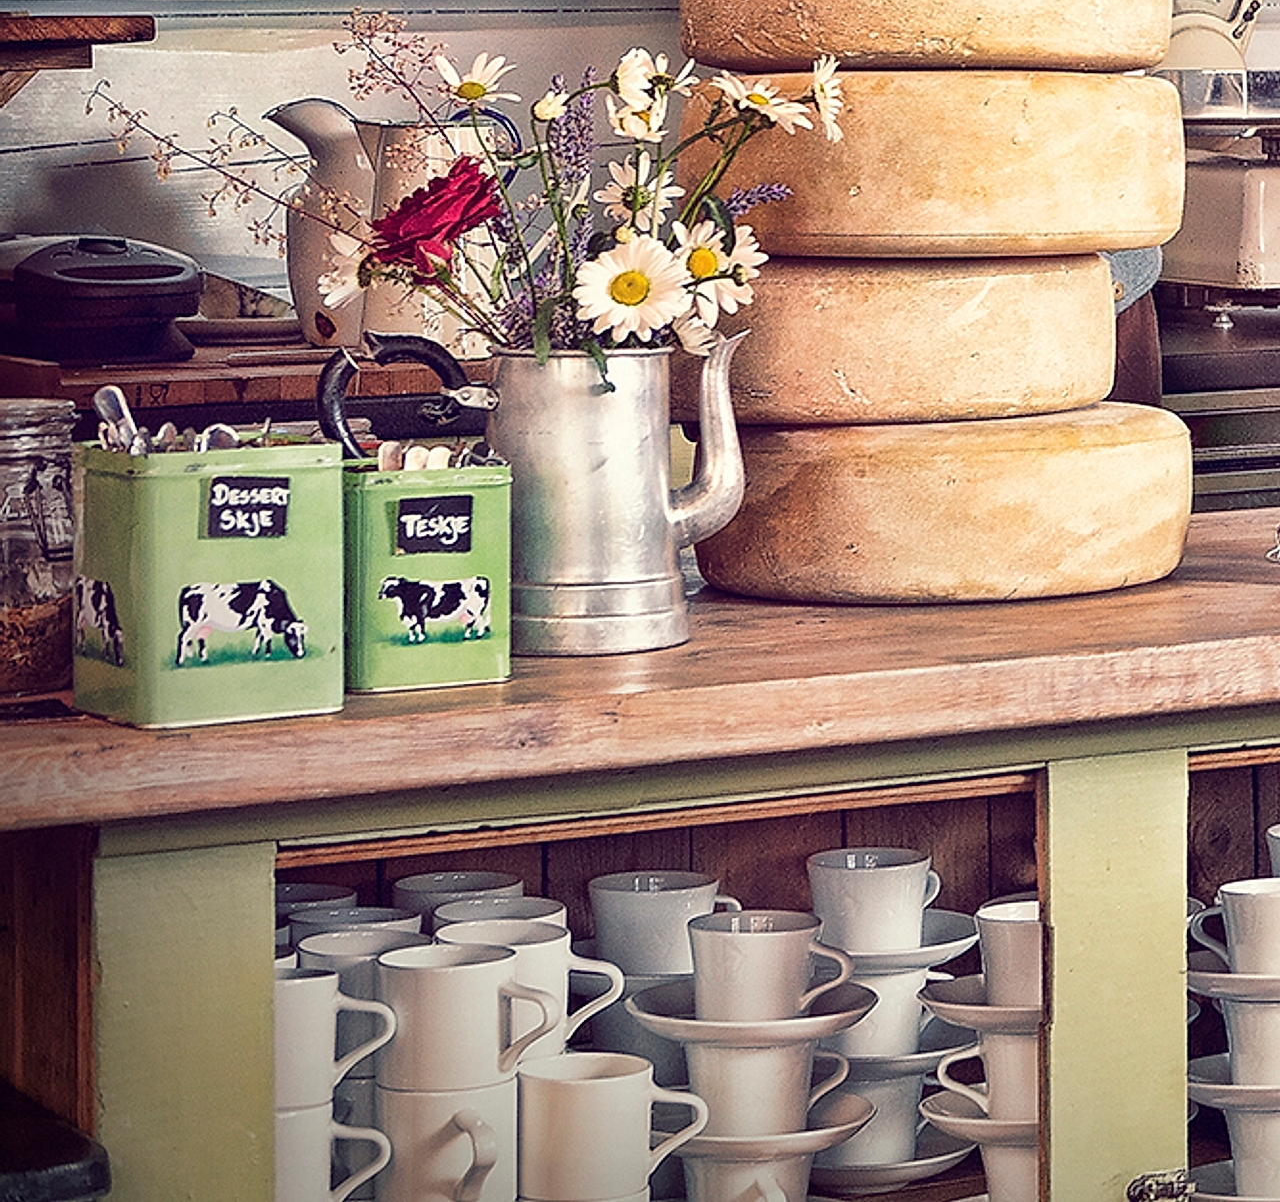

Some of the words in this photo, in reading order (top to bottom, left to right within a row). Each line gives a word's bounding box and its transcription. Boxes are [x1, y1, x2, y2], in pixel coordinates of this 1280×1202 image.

[211, 483, 290, 506] DESSERT
[220, 509, 273, 537] SKJE
[400, 513, 469, 545] TESKJE
